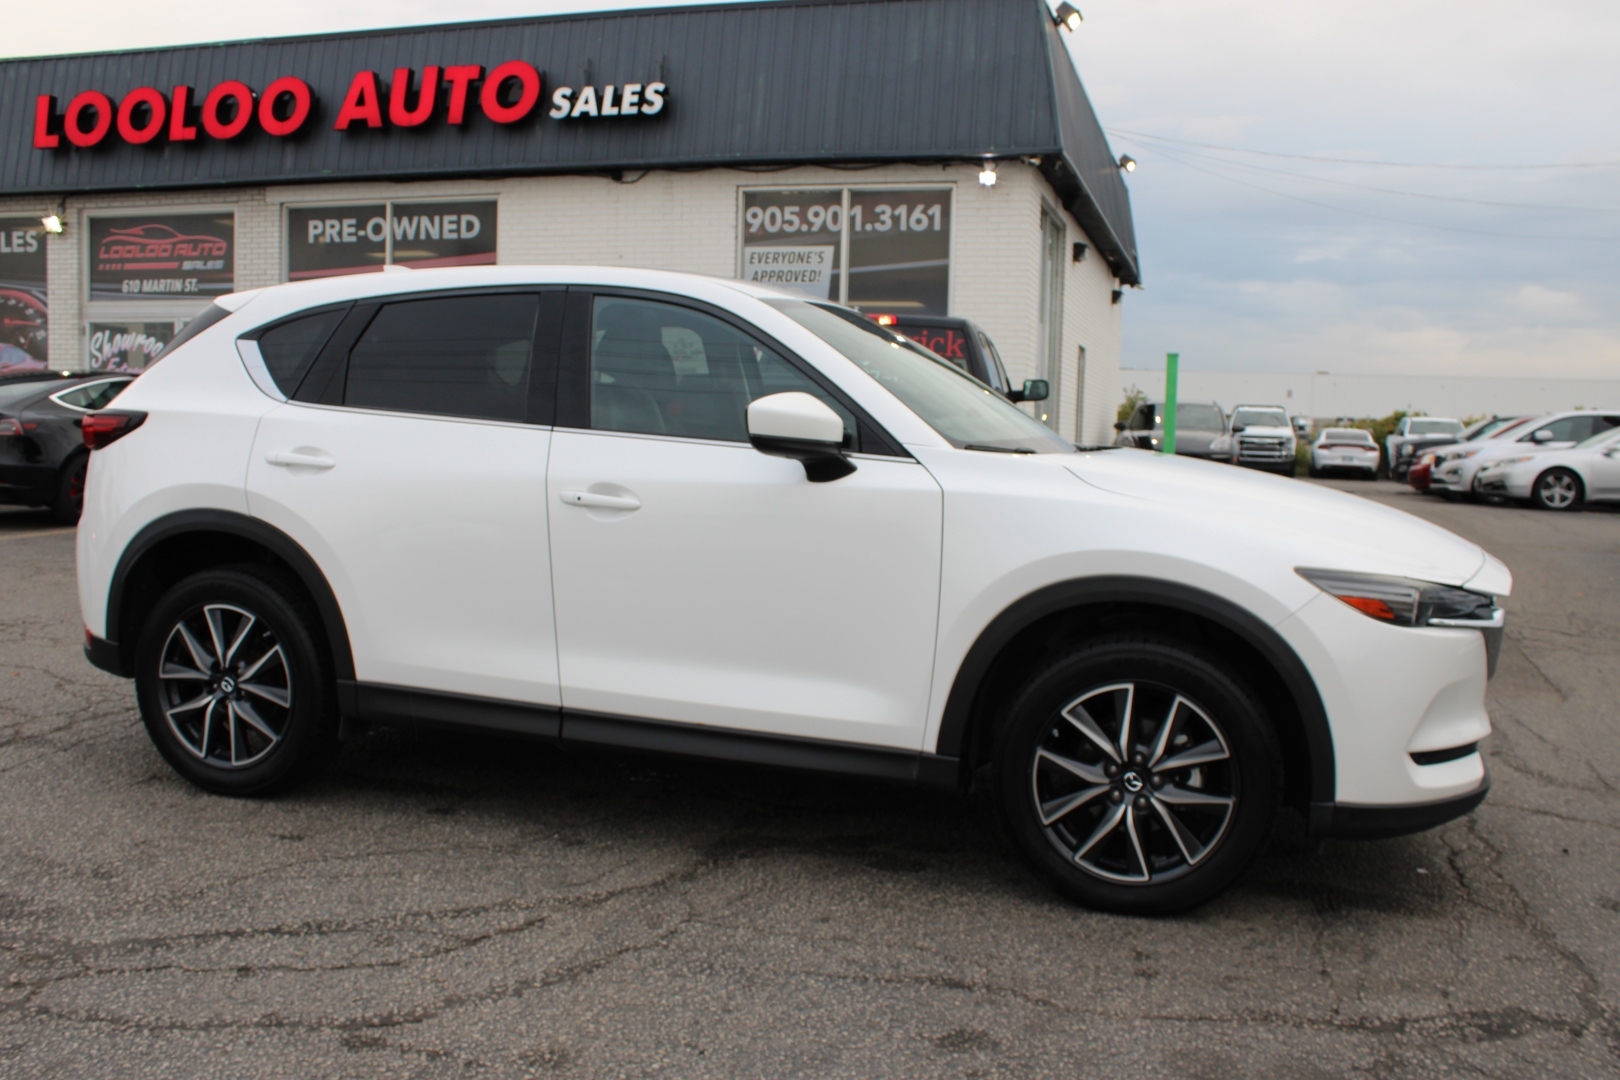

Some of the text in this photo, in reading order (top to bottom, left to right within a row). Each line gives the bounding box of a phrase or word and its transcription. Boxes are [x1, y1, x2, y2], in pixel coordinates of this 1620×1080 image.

[33, 60, 667, 149] LOOLOO AUTO SALES
[745, 204, 942, 234] 905.901.3161
[308, 214, 481, 244] PRE-OWNED
[0, 230, 39, 253] LES
[98, 242, 227, 259] LOOLOO AUTO
[749, 251, 825, 265] EVERYONE'S
[181, 260, 225, 270] SALES
[751, 269, 822, 283] APPROVED!
[121, 278, 198, 293] 610 MARTIN ST.
